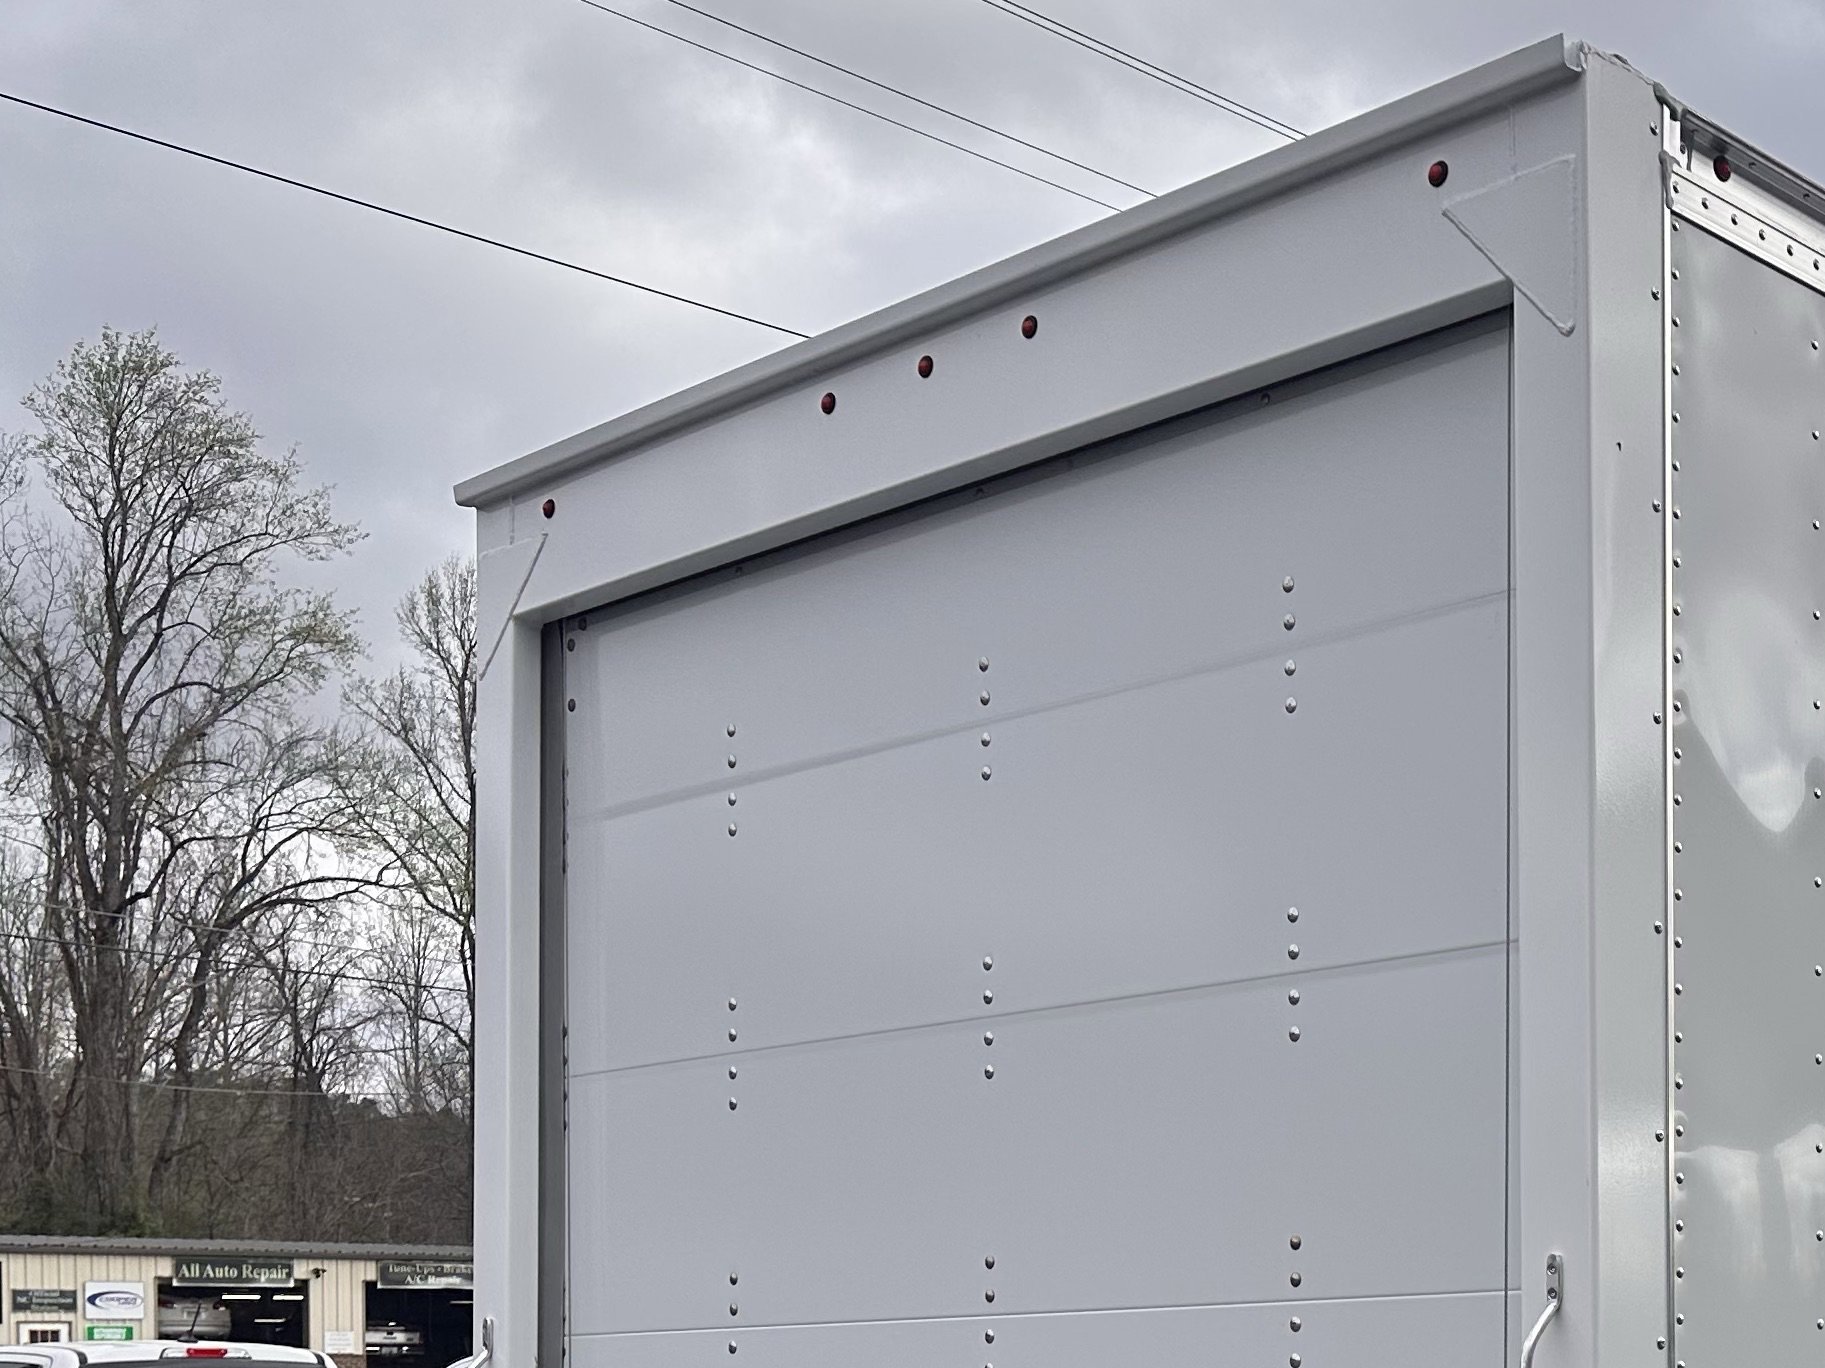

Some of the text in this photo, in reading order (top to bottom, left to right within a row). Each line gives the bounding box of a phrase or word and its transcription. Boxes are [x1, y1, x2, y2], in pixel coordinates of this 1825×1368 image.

[178, 1263, 289, 1282] All Auto Repair
